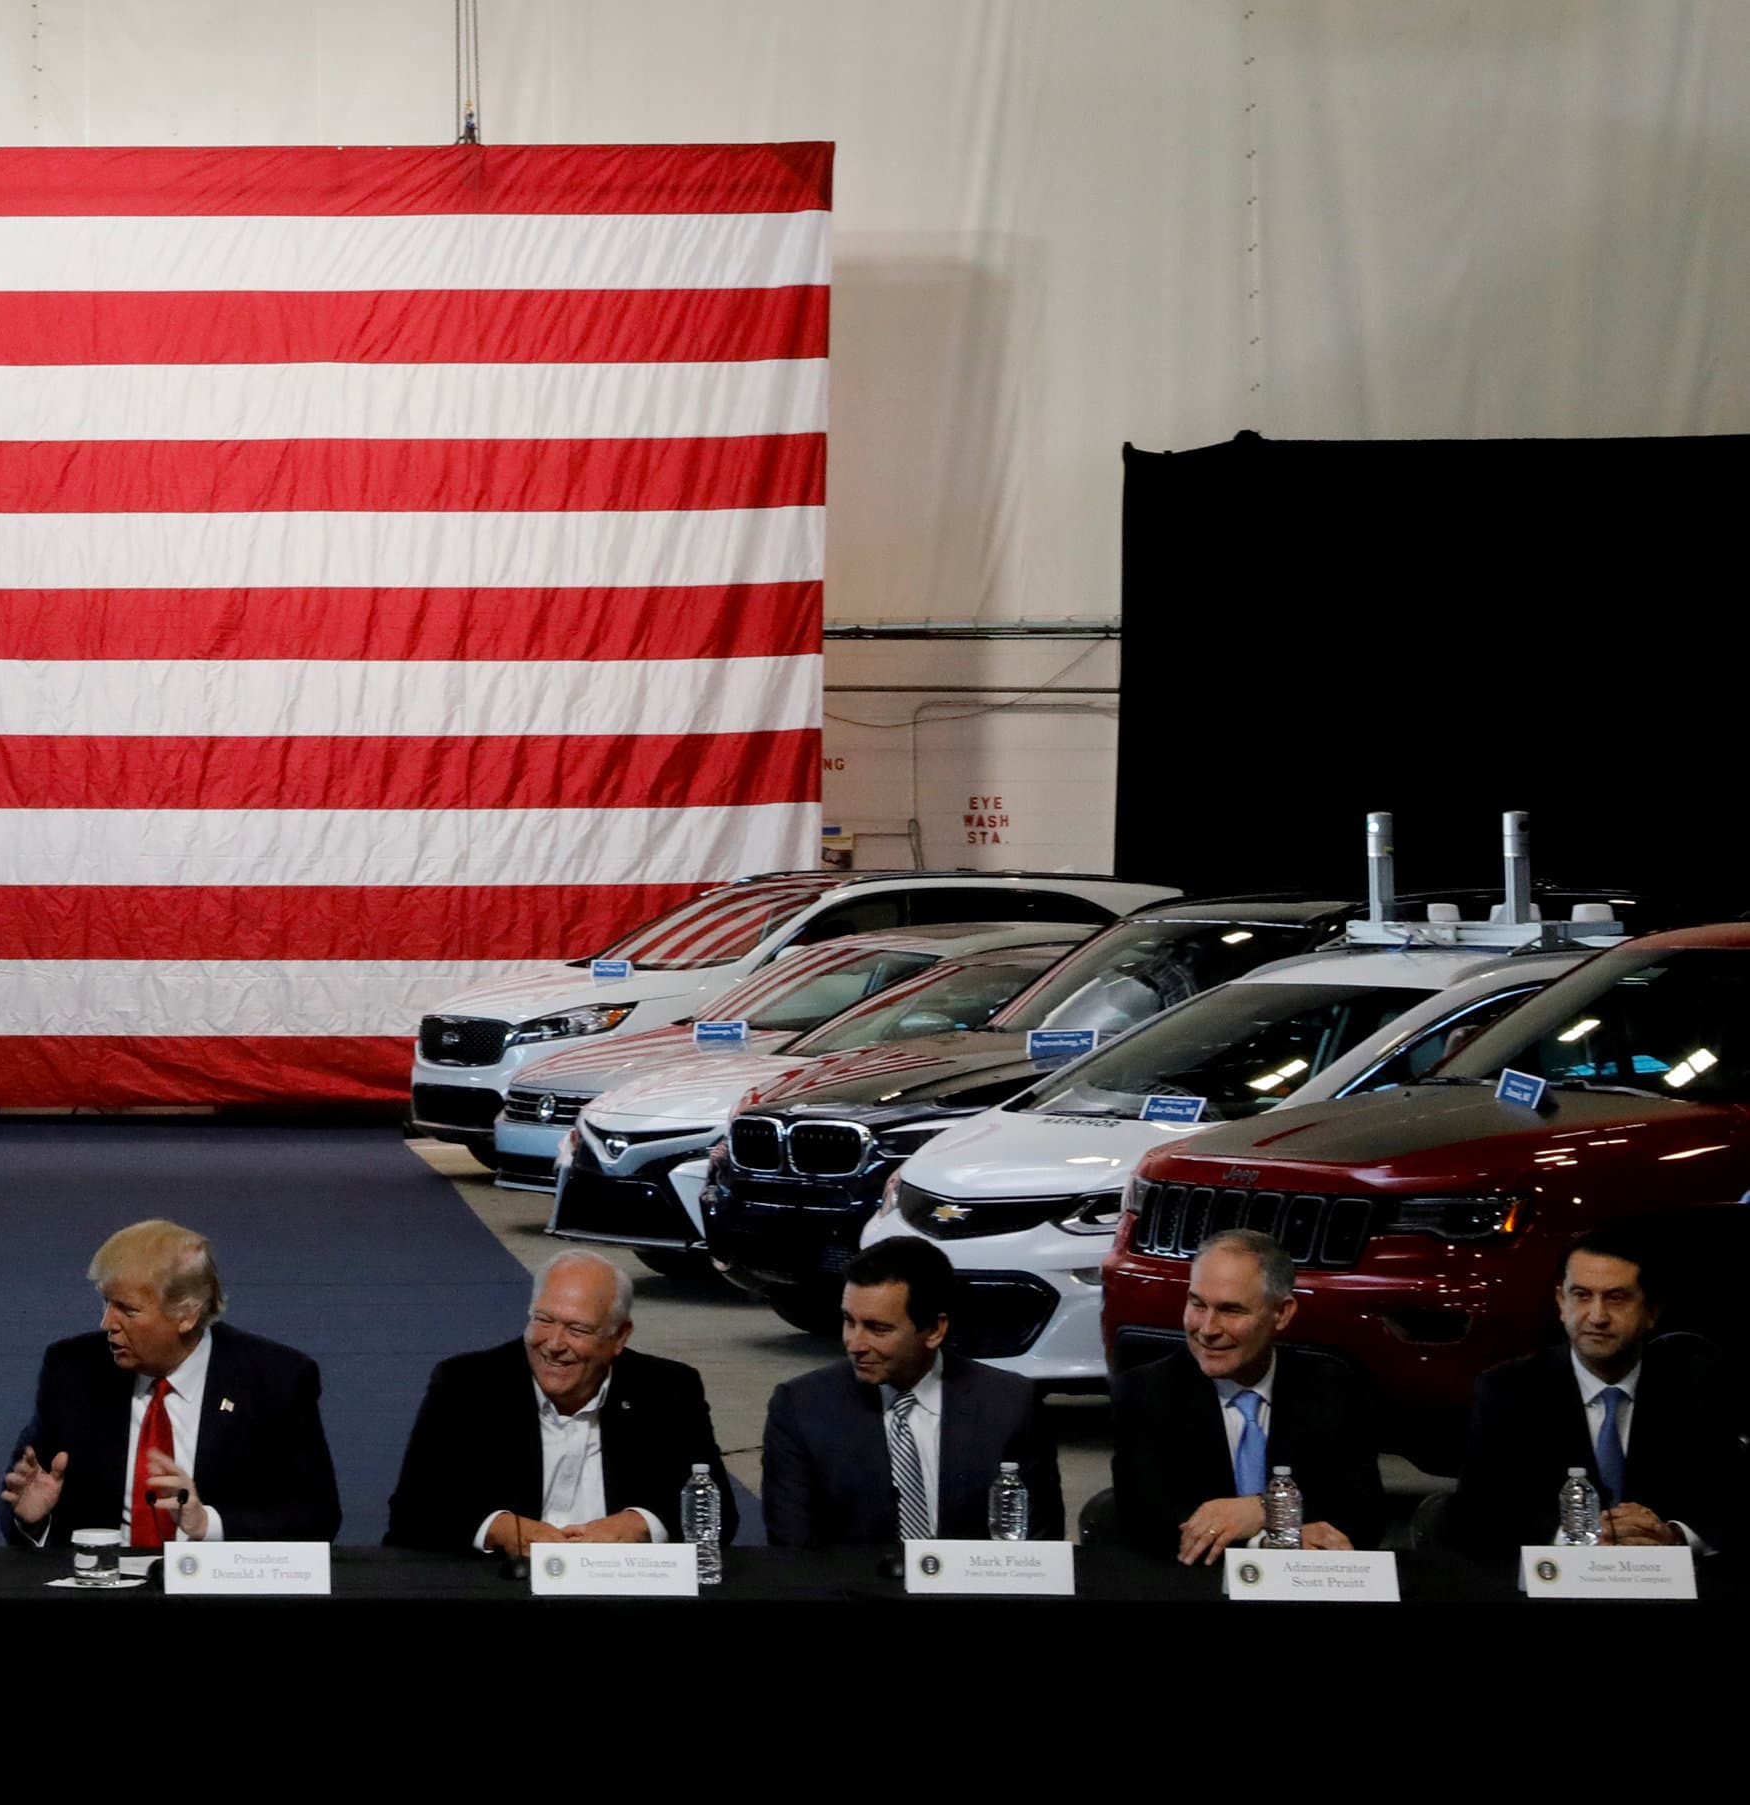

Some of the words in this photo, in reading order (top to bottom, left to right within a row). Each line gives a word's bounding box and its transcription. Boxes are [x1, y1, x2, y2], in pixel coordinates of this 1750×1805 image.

[969, 796, 1002, 810] EYE
[963, 815, 1010, 828] WASH
[967, 831, 1010, 845] STA.
[233, 1553, 290, 1565] President
[579, 1557, 621, 1568] Dennis
[624, 1557, 678, 1568] Williams
[969, 1555, 1002, 1567] Mark
[1005, 1555, 1042, 1567] Fields
[1283, 1561, 1371, 1574] Administrator
[1587, 1561, 1617, 1572] Jose
[212, 1569, 255, 1580] Donald
[271, 1568, 312, 1581] Trump
[1291, 1576, 1323, 1588] Scott
